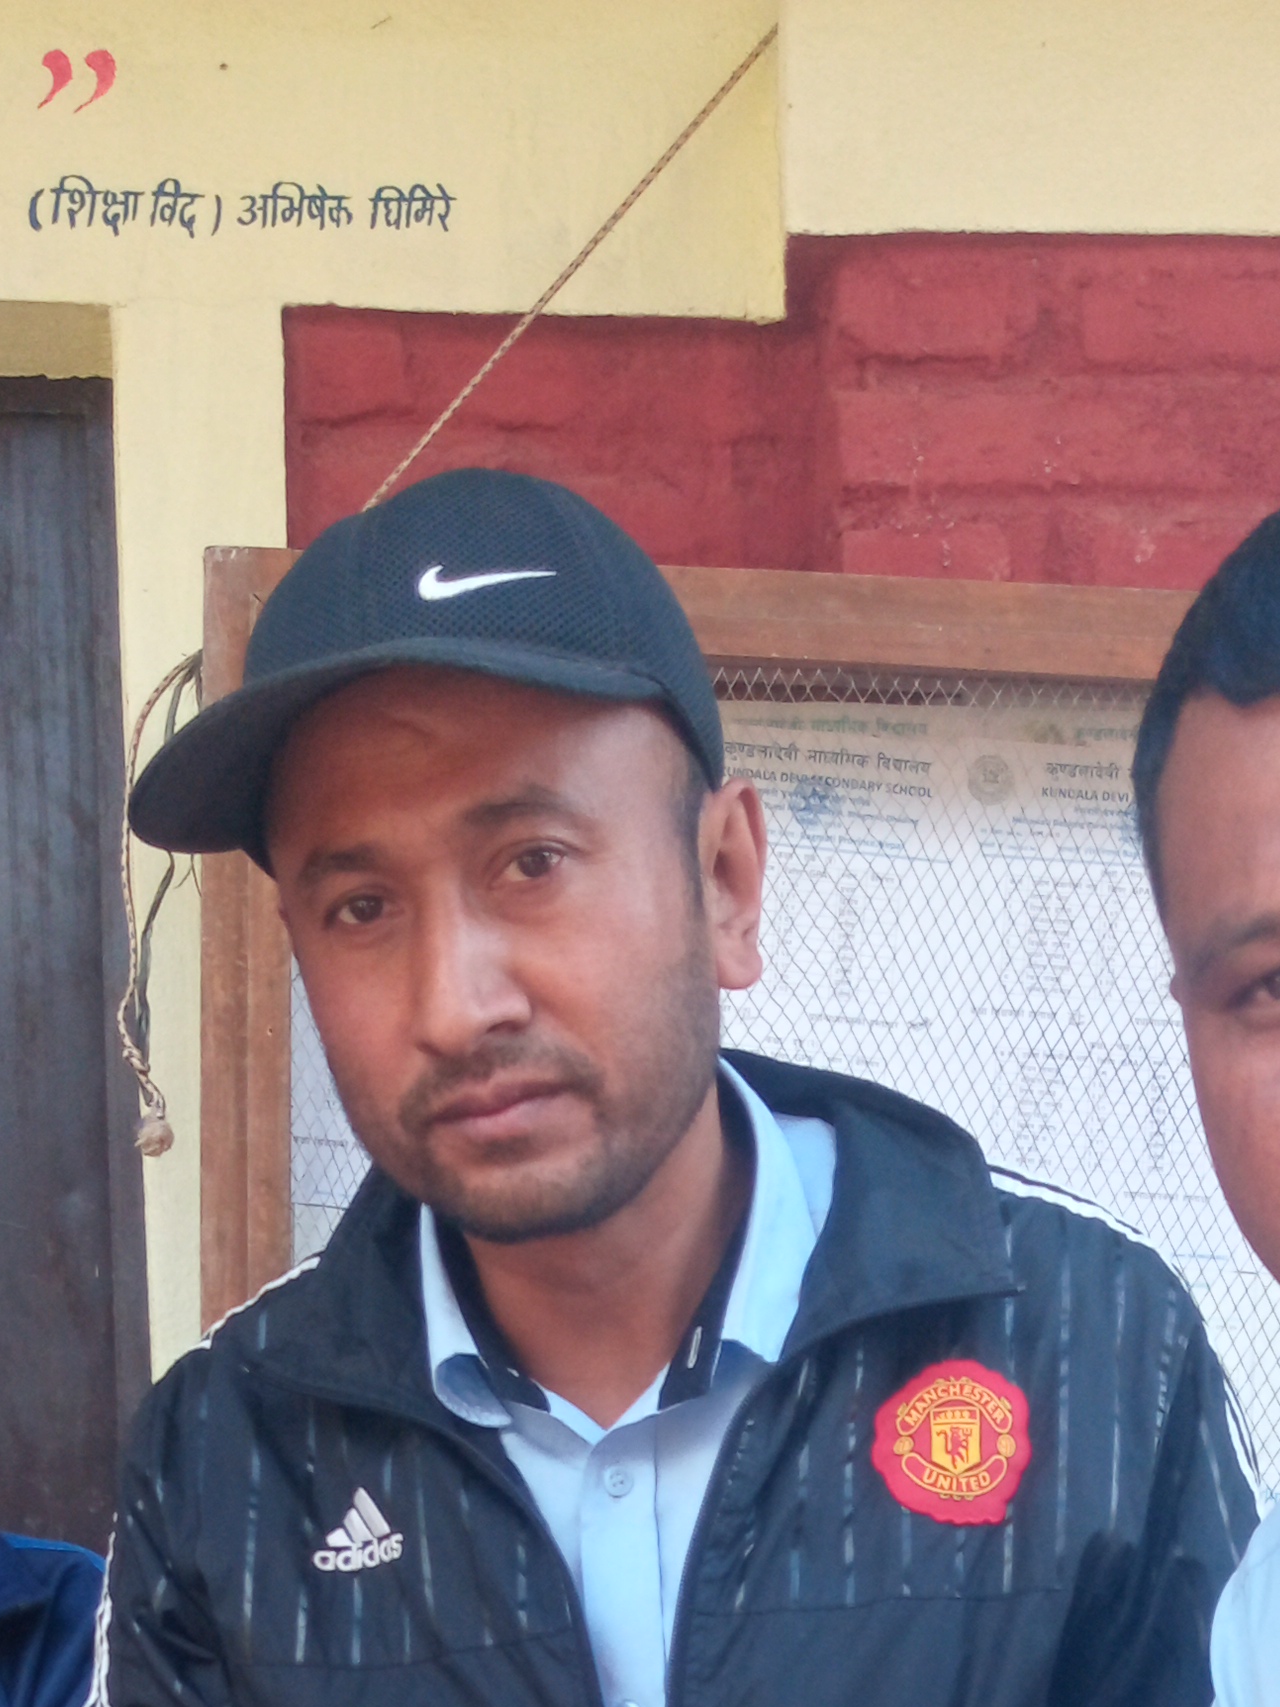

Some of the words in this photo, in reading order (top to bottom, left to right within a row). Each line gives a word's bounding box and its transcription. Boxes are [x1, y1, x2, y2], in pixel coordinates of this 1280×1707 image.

[904, 1384, 1005, 1427] MANCHESTER
[923, 1467, 991, 1494] UNITED
[313, 1533, 404, 1572] adidas
